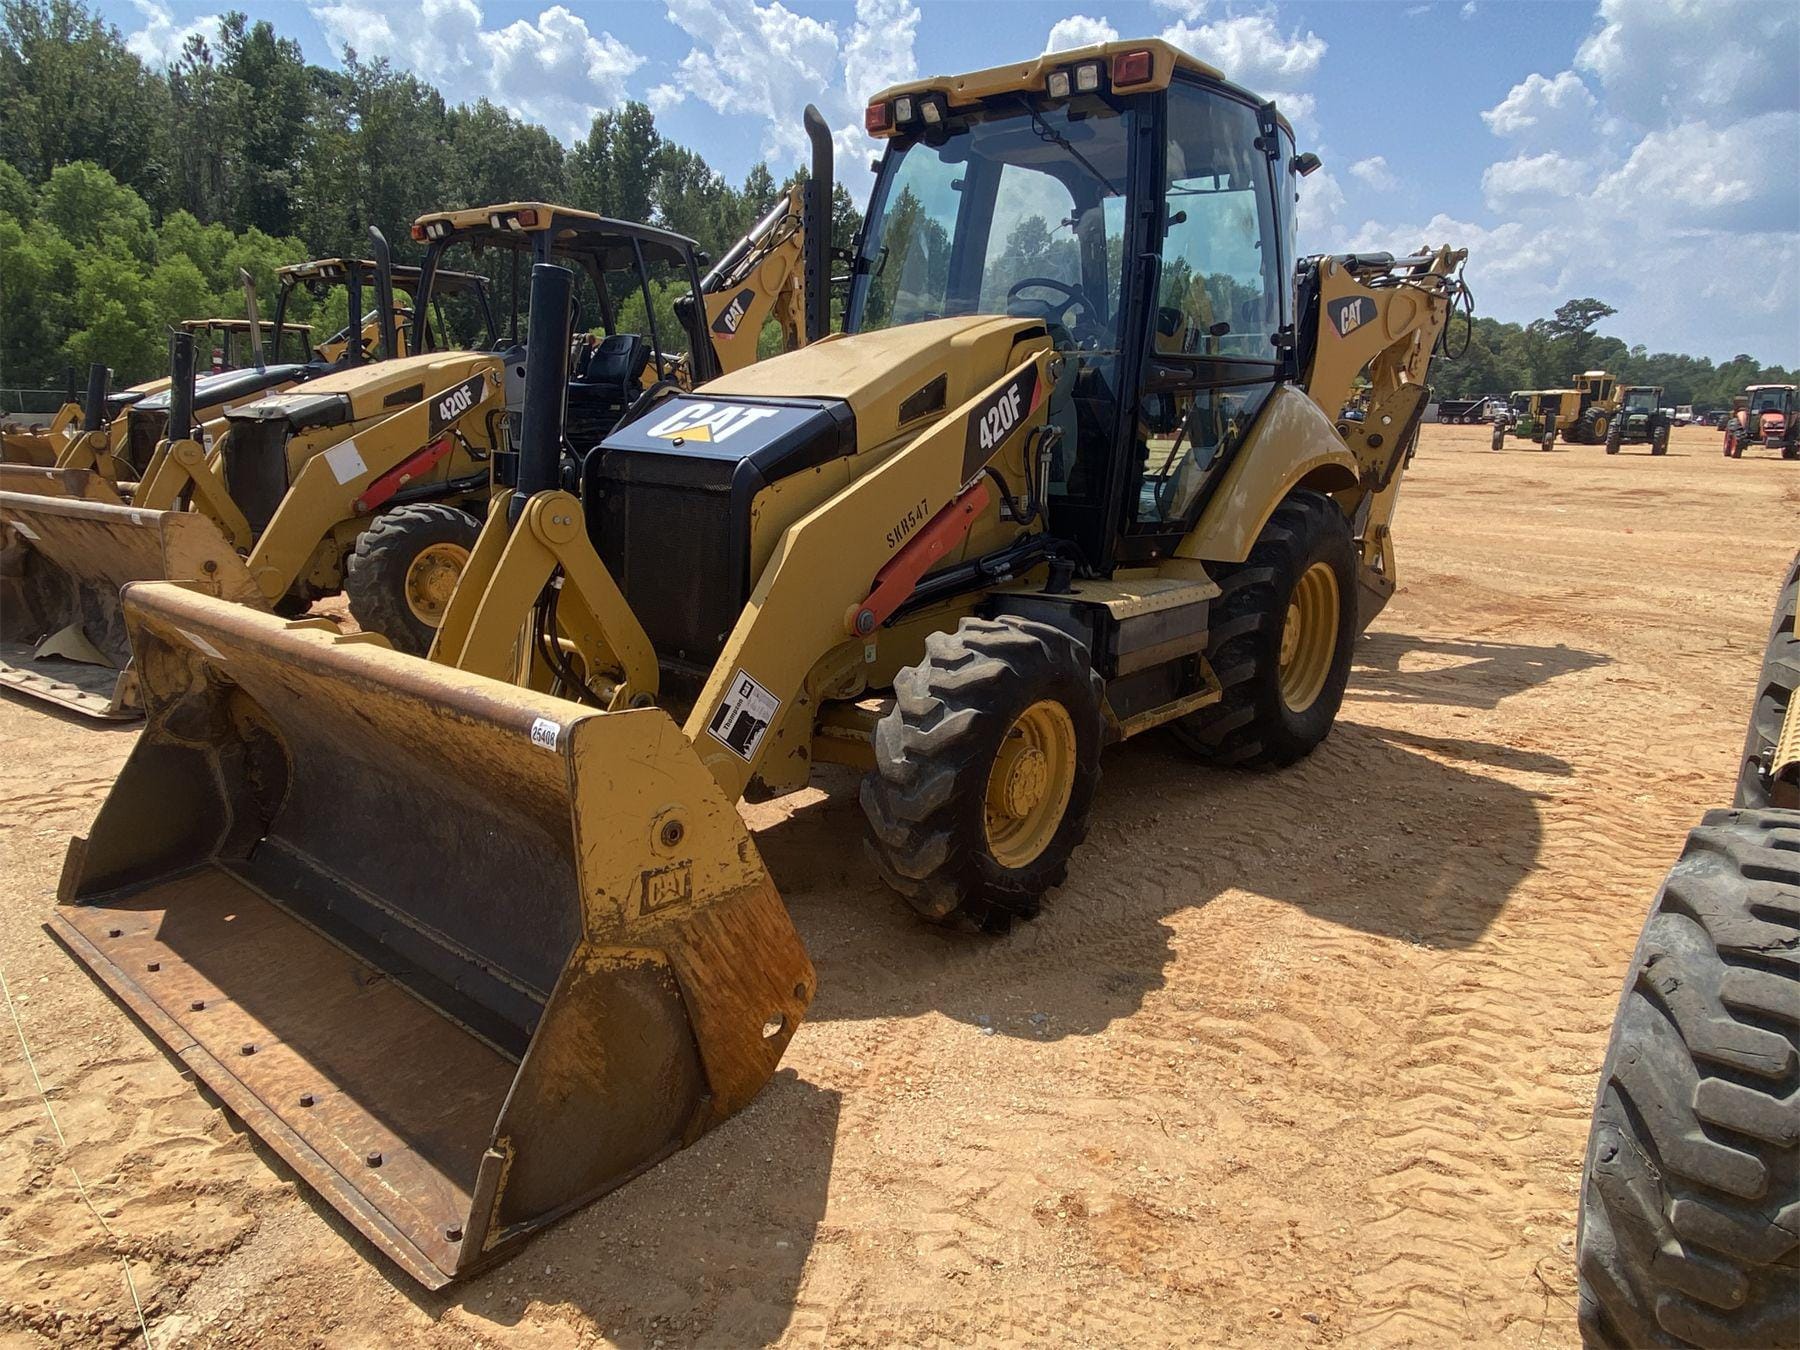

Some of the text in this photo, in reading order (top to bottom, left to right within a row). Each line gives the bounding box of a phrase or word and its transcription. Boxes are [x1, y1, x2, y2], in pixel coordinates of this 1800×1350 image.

[725, 298, 745, 332] CAT
[1340, 298, 1362, 335] CAT
[439, 384, 472, 420] 420F
[979, 382, 1021, 449] 420F
[647, 403, 780, 444] CAT
[723, 698, 744, 730] Thompson
[532, 726, 556, 747] 25408
[648, 866, 687, 908] CAT
